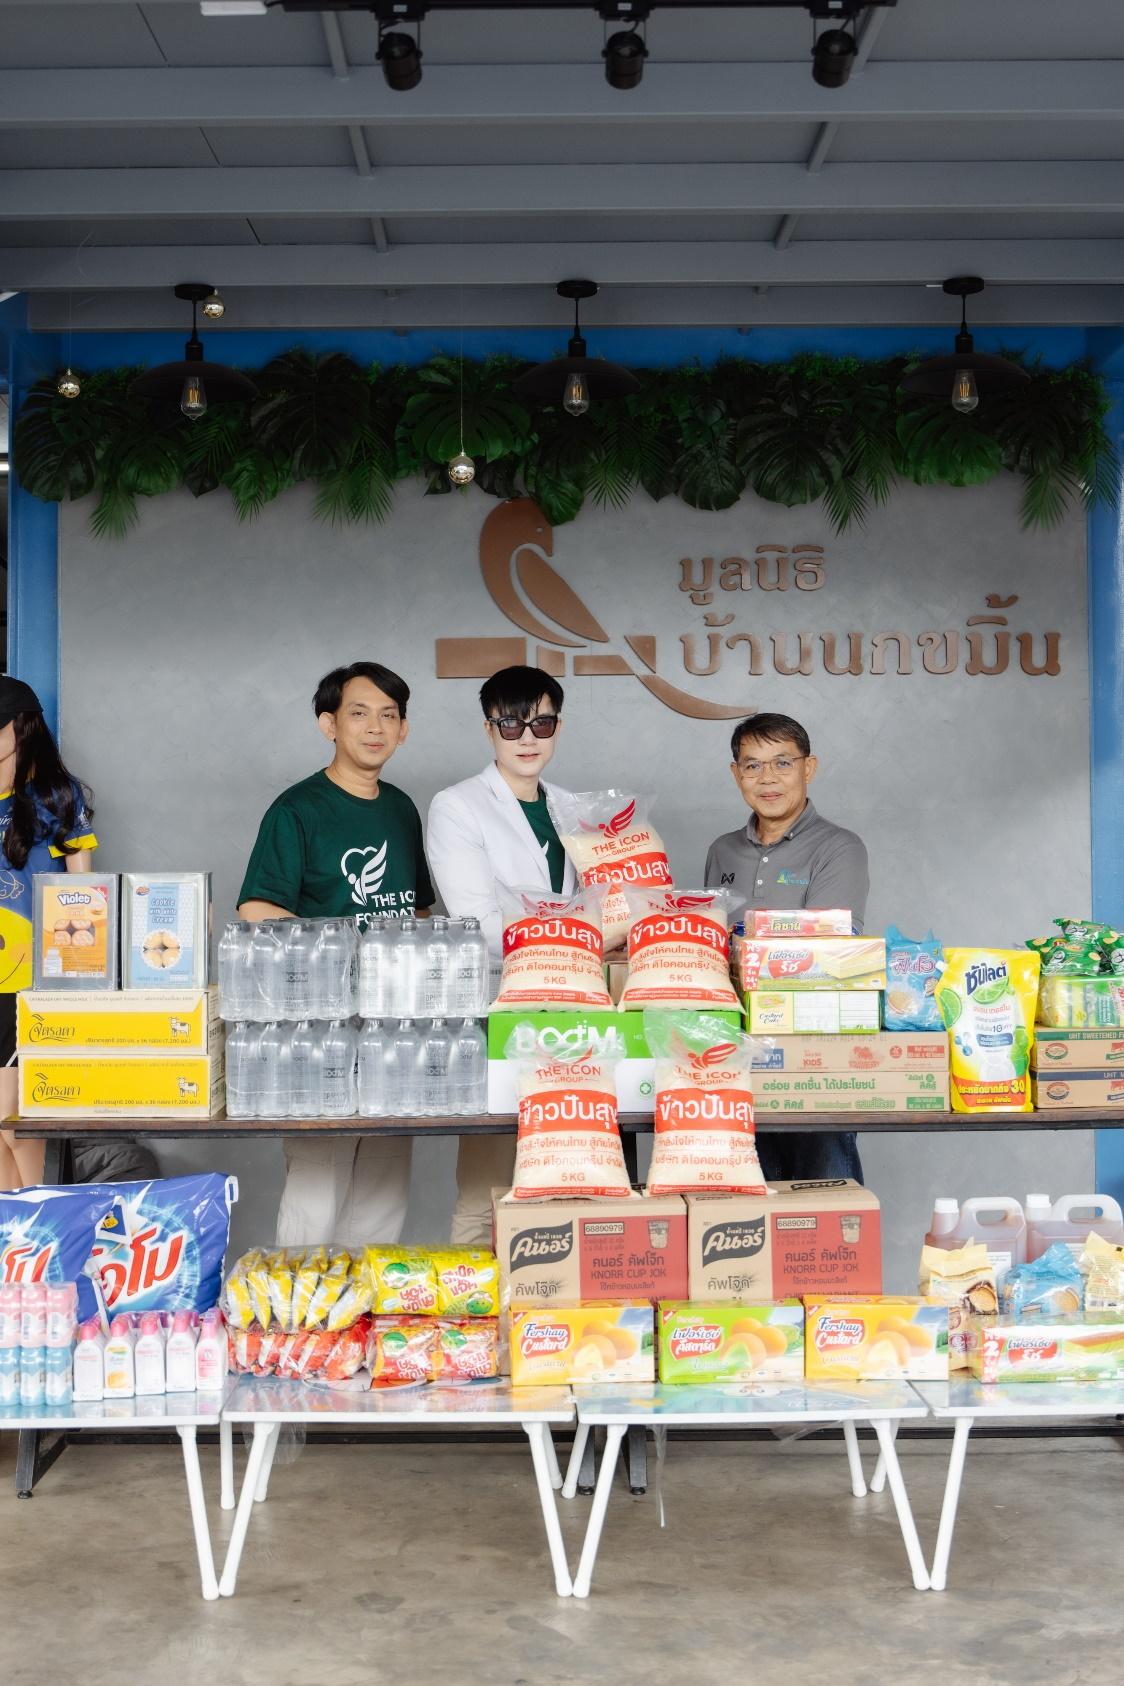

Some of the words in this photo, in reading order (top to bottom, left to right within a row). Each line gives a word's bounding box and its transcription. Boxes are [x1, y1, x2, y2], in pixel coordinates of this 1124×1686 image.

[679, 545, 826, 606] มูลนิธิ
[680, 594, 1061, 677] บ้านนกขมิ้น
[591, 841, 617, 856] THE
[611, 845, 636, 856] GROUP
[57, 892, 91, 907] Violet
[371, 893, 397, 908] THE
[745, 952, 760, 967] 2
[551, 976, 567, 985] KG
[677, 974, 693, 983] KG
[535, 1066, 562, 1081] THE
[763, 1079, 790, 1091] อร่อย
[794, 1076, 821, 1091] สดชื่น
[823, 1077, 876, 1090] ได้ประโยชน์
[561, 1172, 568, 1182] 5
[570, 1172, 585, 1182] KG
[699, 1172, 706, 1181] 5
[707, 1172, 723, 1181] KG
[585, 1225, 624, 1233] 68890979
[776, 1218, 817, 1228] 68890979
[511, 1232, 572, 1262] คนอร์
[703, 1226, 765, 1256] คนอร์
[592, 1254, 624, 1268] คนอร์
[784, 1248, 816, 1263] คนอร์
[591, 1270, 624, 1280] KNORR
[626, 1269, 647, 1279] CUP
[648, 1268, 666, 1278] JOK
[783, 1264, 816, 1274] KNORR
[819, 1263, 839, 1273] CUP
[842, 1262, 860, 1273] JOK
[524, 1323, 568, 1339] Fershay
[818, 1316, 862, 1335] Fershay
[521, 1337, 568, 1354] Custard
[815, 1331, 863, 1348] Custard
[983, 1341, 1001, 1358] 2
